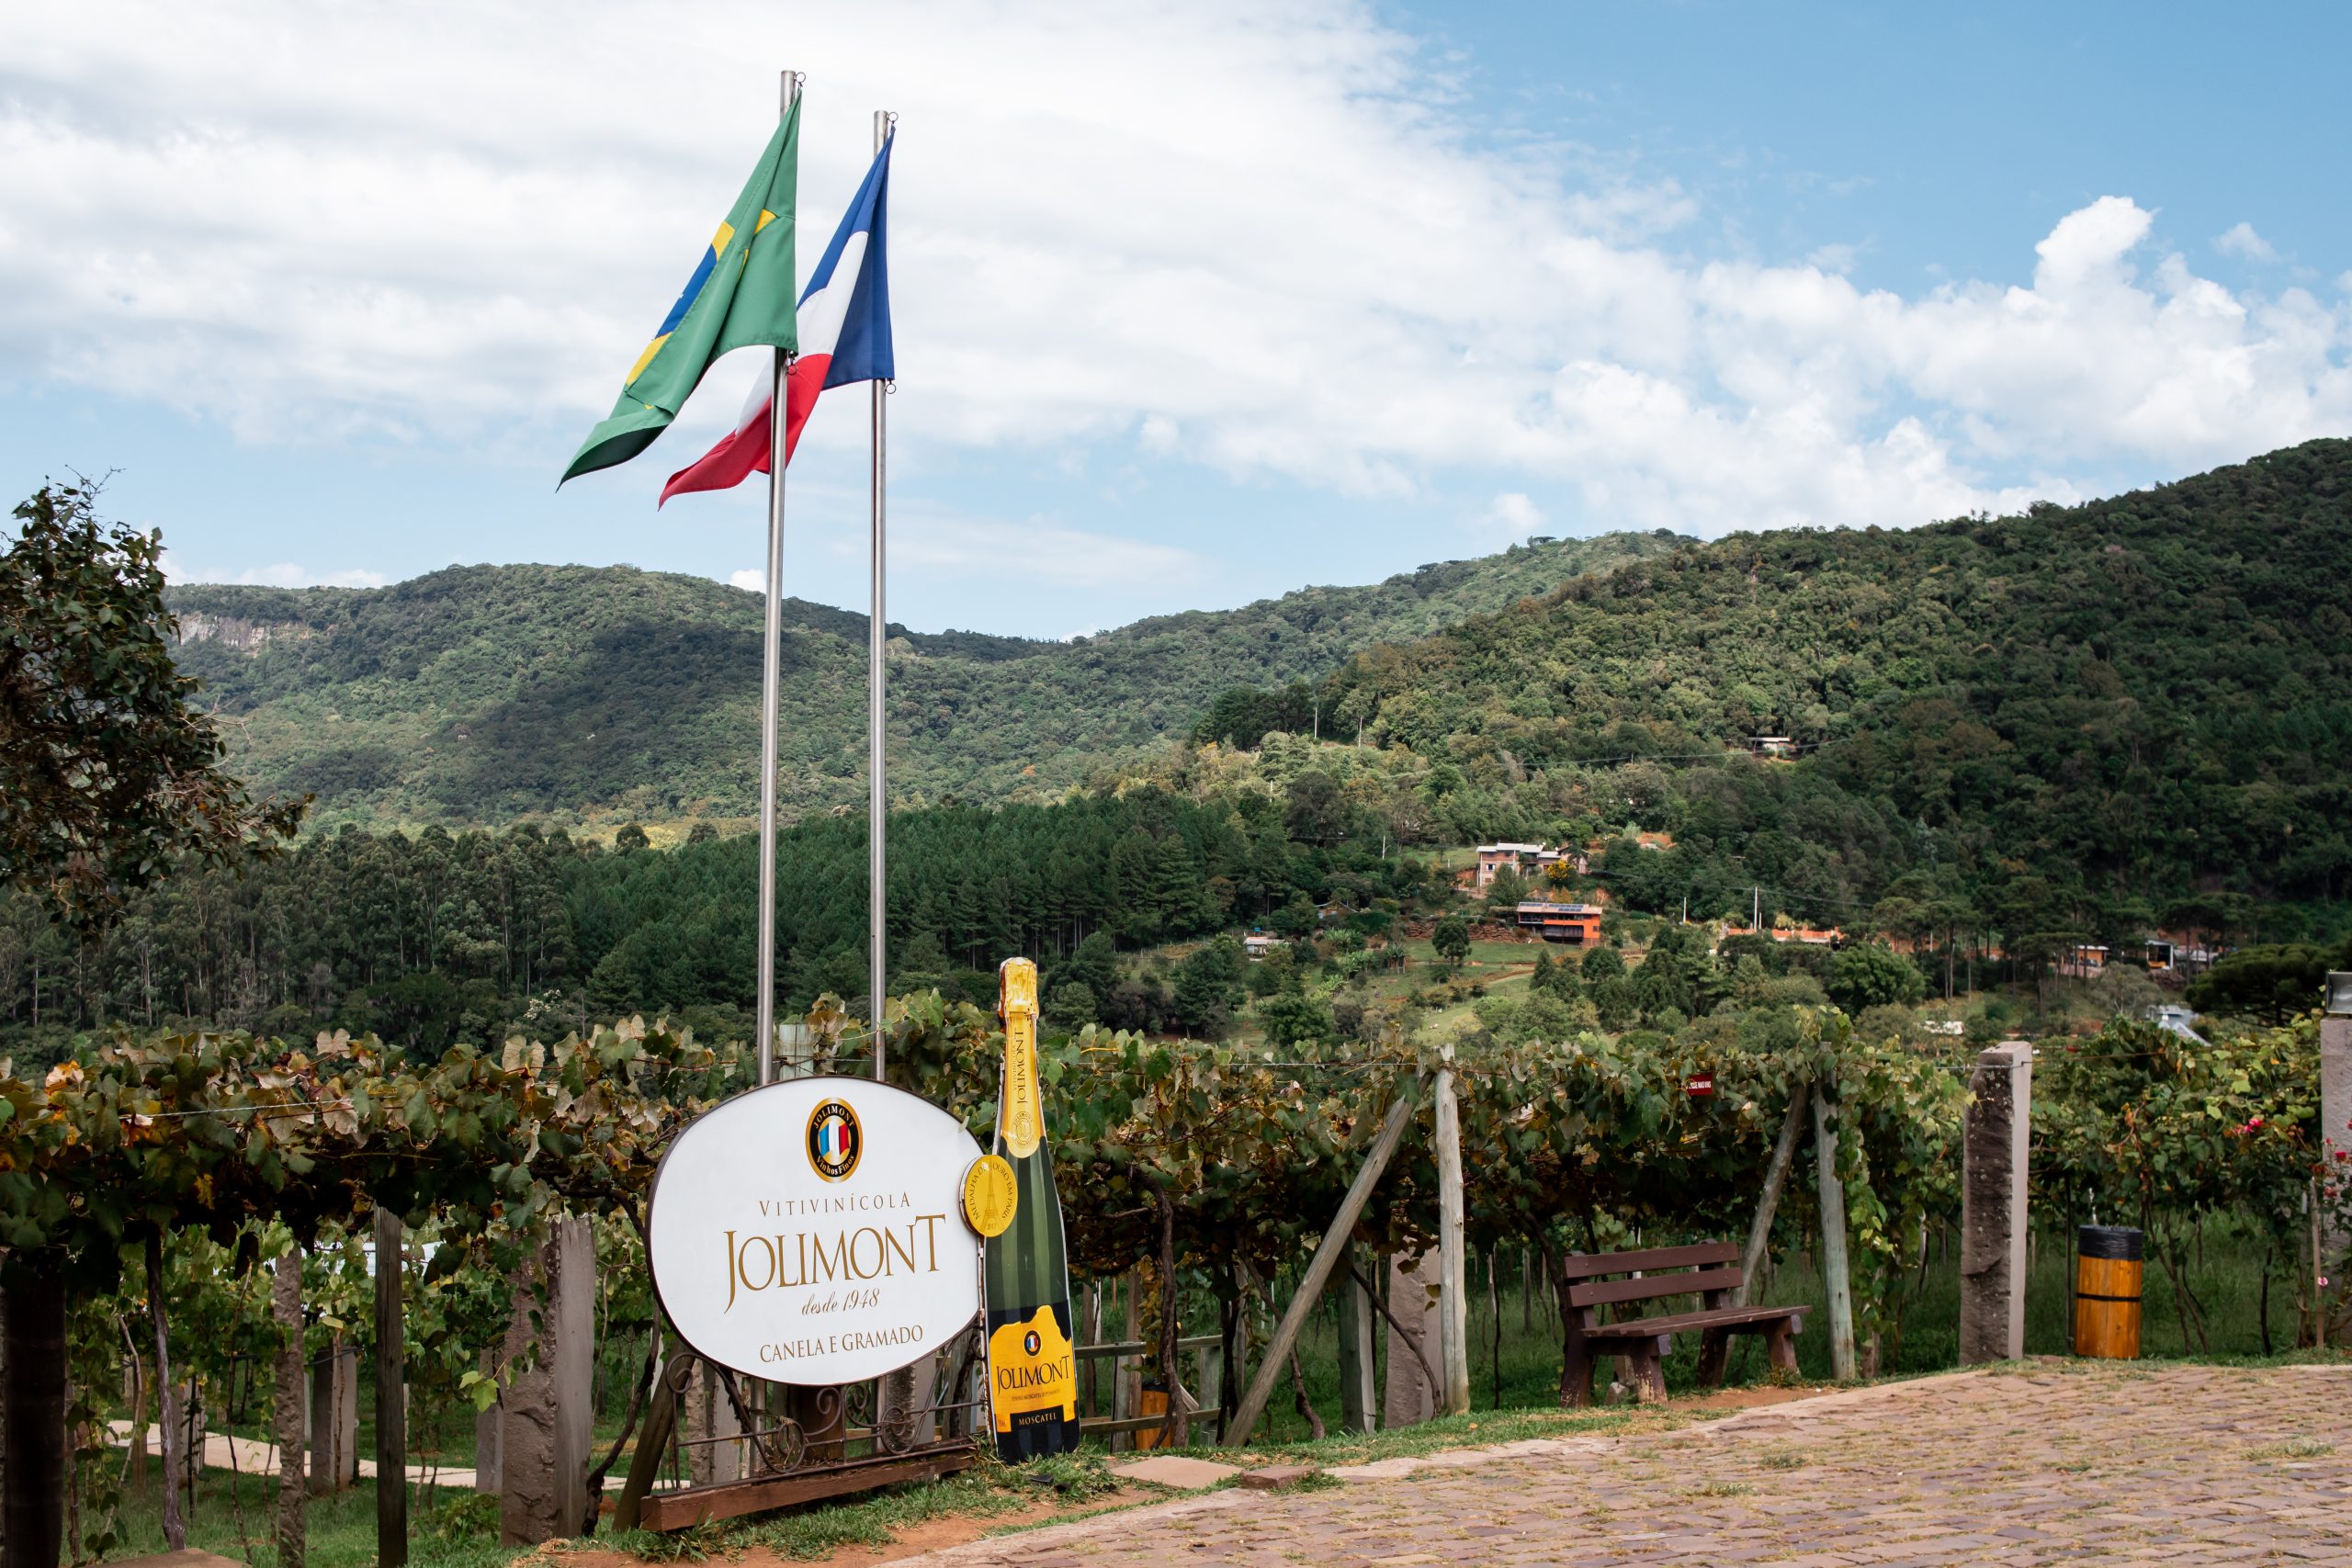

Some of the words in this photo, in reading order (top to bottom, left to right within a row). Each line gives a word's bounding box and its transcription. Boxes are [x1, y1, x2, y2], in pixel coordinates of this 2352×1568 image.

[1014, 1027, 1028, 1104] JOLIMONT
[813, 1105, 855, 1129] JOLIMONT
[817, 1156, 838, 1176] Vinhos
[838, 1155, 854, 1175] Finos
[759, 1191, 910, 1218] VITIVINÍCOLA
[968, 1175, 980, 1220] MEDALHA
[992, 1162, 1010, 1181] OURO
[1006, 1181, 1012, 1196] EM
[723, 1213, 946, 1315] JOLIMONT
[801, 1293, 838, 1316] desde
[842, 1288, 880, 1313] 1948
[760, 1338, 825, 1363] CANELA
[830, 1336, 838, 1354] E
[842, 1325, 923, 1352] GRAMADO
[996, 1355, 1069, 1396] JOLIMONT
[1018, 1412, 1057, 1426] MOSCATEL
